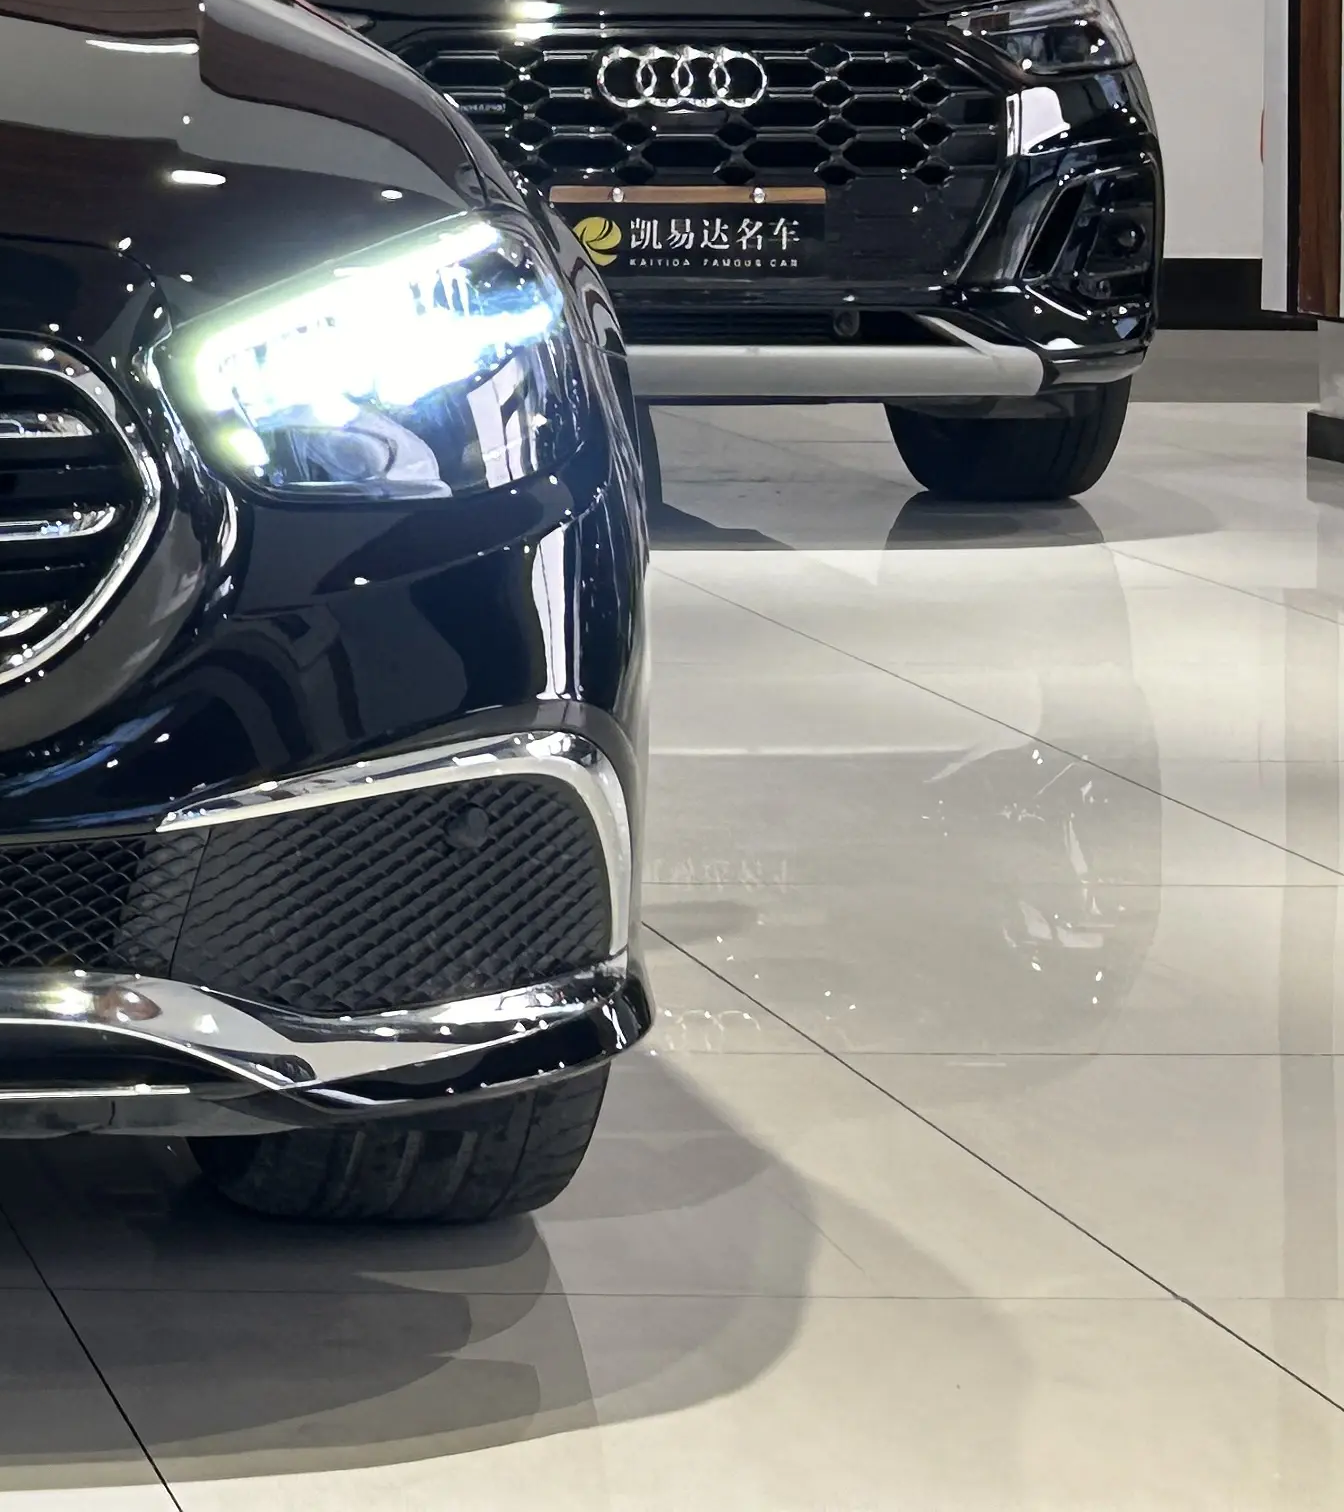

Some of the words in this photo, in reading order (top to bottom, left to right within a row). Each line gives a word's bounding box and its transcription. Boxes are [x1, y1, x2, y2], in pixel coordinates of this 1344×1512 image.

[629, 217, 801, 251] 凯易达名车
